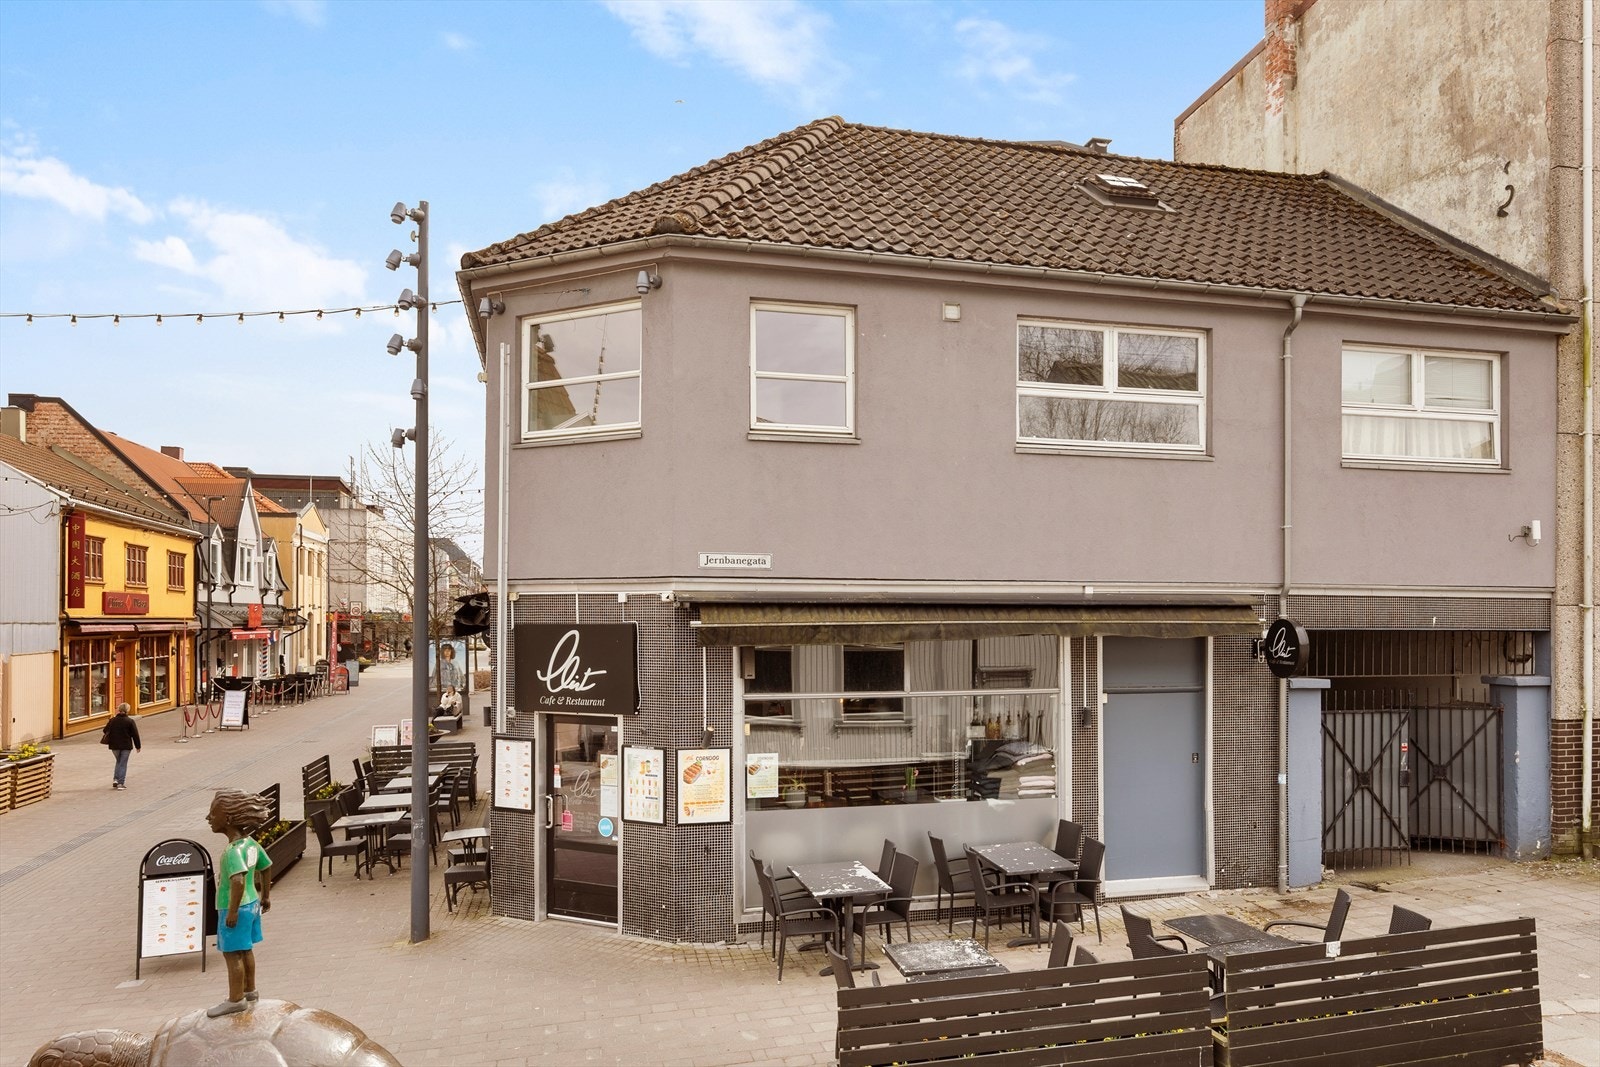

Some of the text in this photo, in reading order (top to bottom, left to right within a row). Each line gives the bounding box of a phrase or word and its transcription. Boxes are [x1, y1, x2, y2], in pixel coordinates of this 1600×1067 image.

[704, 555, 767, 566] Jernbanegata
[539, 695, 606, 707] Cafe & Restaurant
